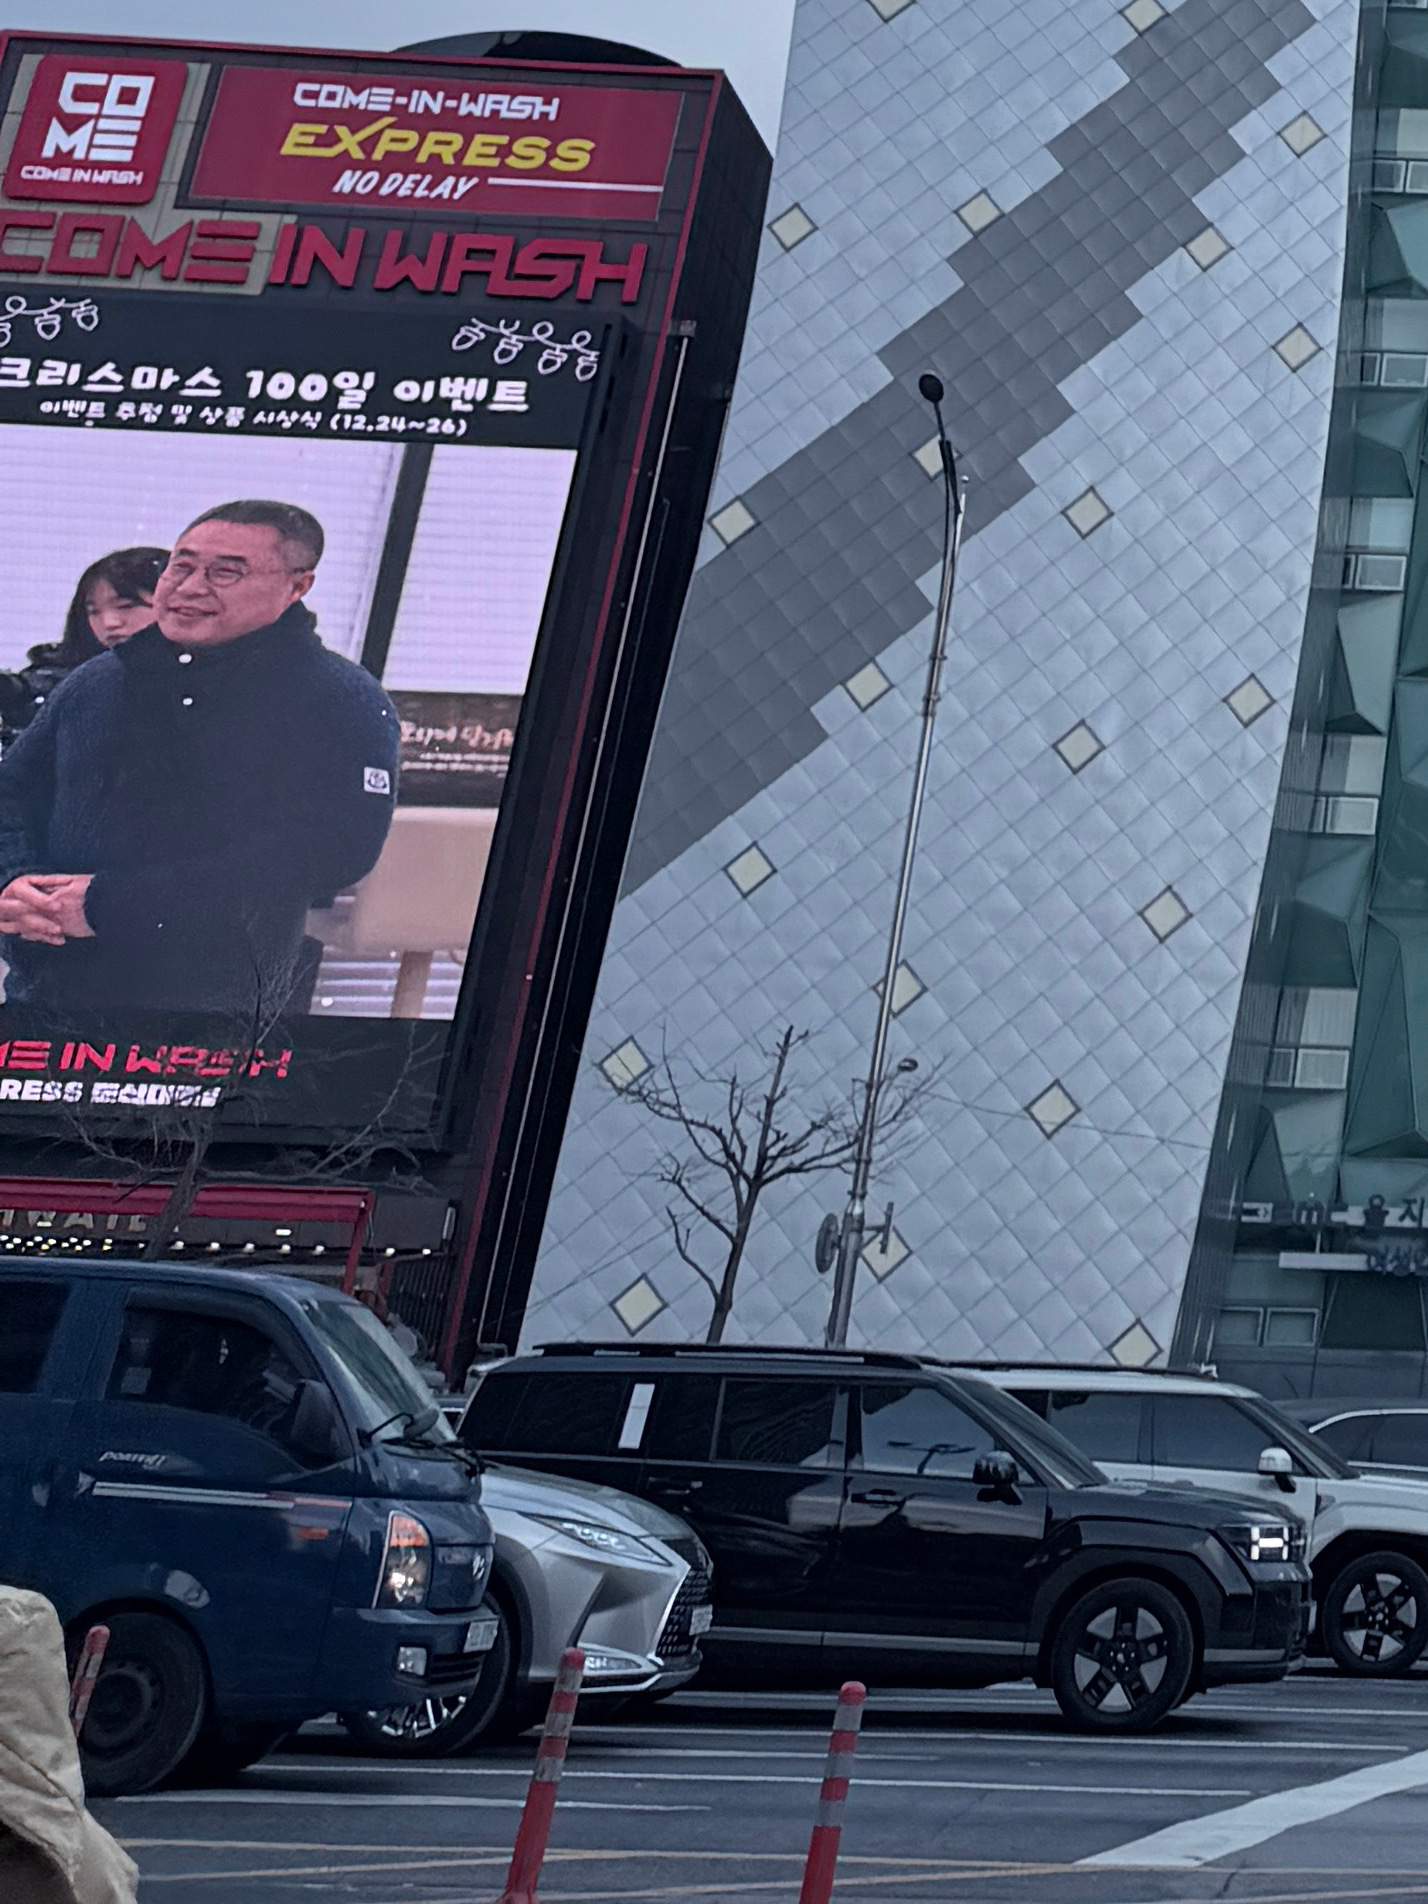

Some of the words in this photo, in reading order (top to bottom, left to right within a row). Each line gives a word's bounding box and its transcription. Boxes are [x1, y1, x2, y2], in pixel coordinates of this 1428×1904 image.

[293, 81, 561, 122] COME-IN-WASH
[279, 116, 597, 173] EXPRESS
[20, 165, 72, 182] COME
[72, 168, 92, 183] IN
[92, 169, 144, 186] WASH
[332, 169, 380, 195] NO
[379, 172, 480, 200] DELAY
[0, 211, 261, 287] COME
[269, 223, 368, 289] IN
[373, 228, 649, 304] WASH
[0, 356, 222, 397] 크리스마스
[245, 369, 376, 410] 100일
[393, 375, 530, 412] 이벤트
[40, 399, 106, 419] 이벤트
[199, 405, 246, 428] 상품
[329, 412, 468, 437] (12.24~26)
[59, 1042, 117, 1072] IN
